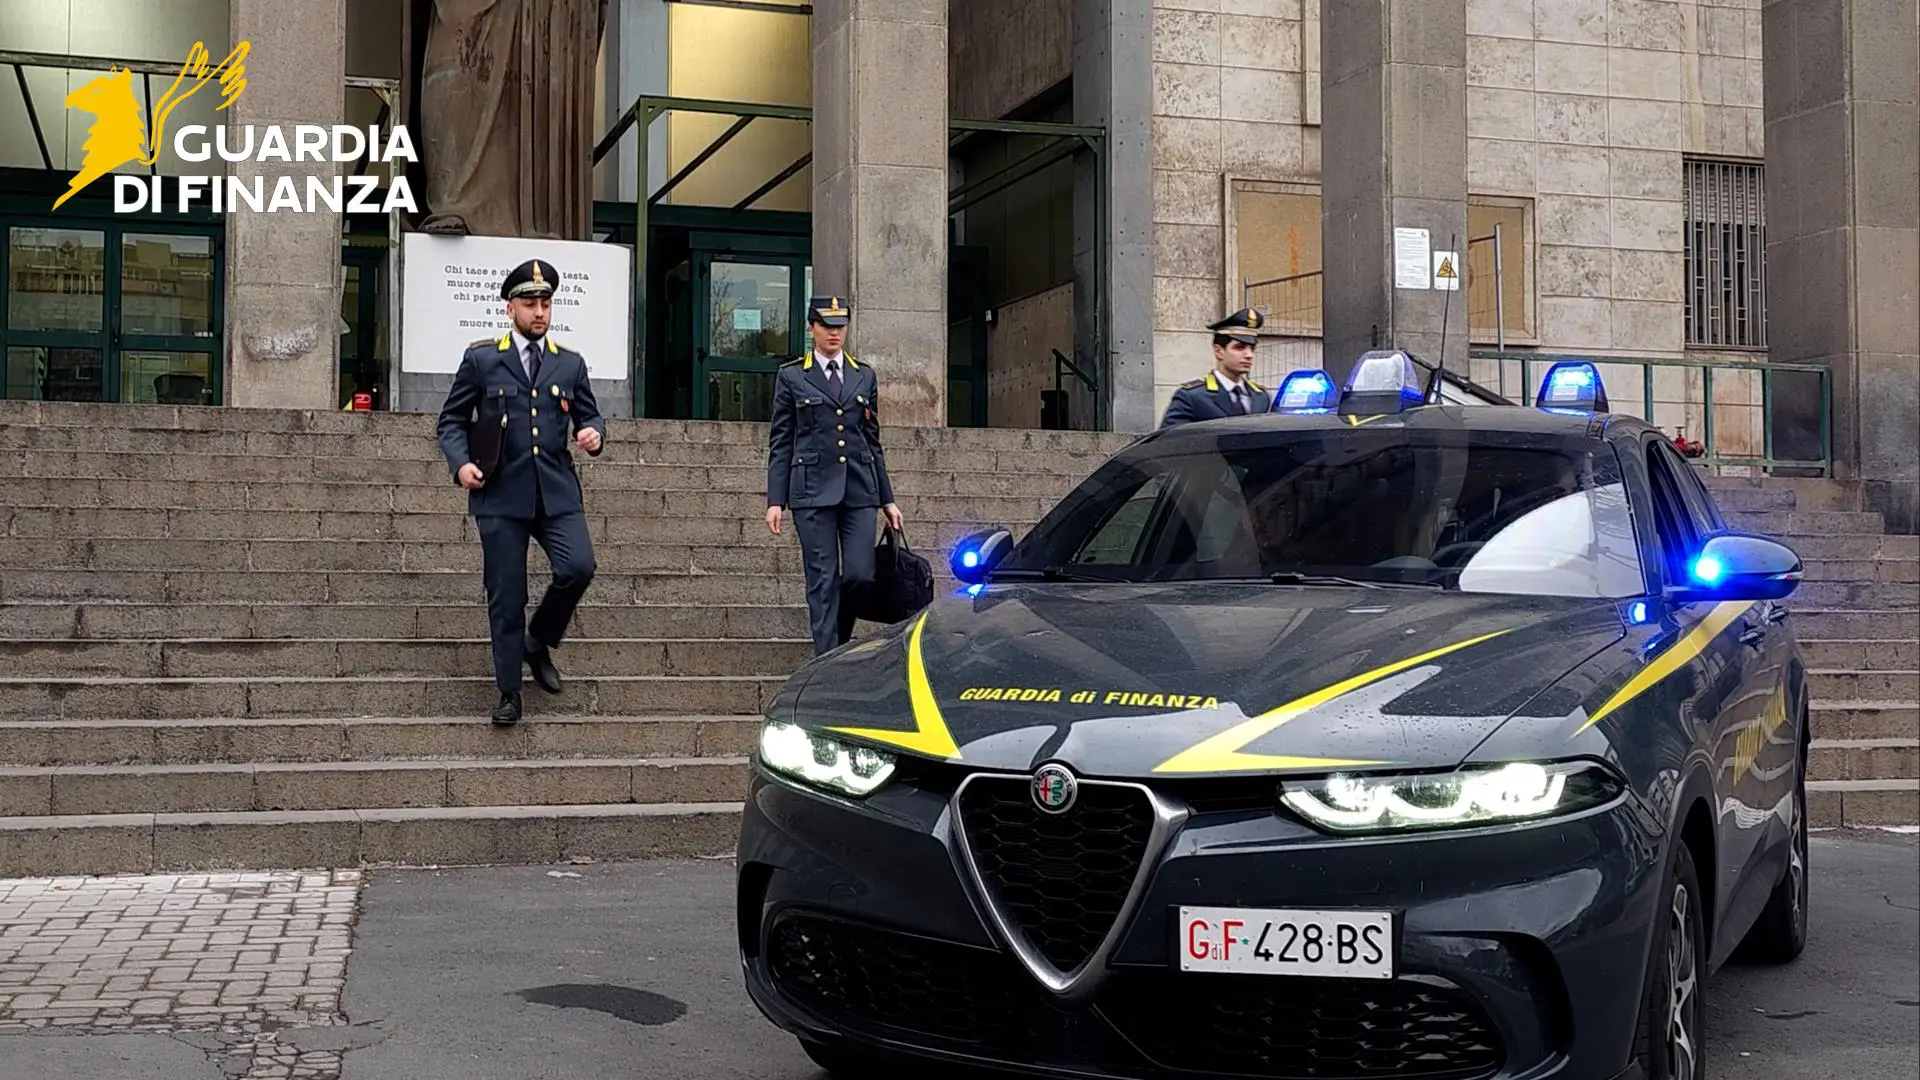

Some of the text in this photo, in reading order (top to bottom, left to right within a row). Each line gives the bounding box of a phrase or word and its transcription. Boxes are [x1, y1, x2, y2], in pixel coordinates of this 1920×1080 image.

[444, 265, 463, 274] Chi
[465, 267, 488, 275] tace
[562, 272, 590, 280] testa
[447, 279, 482, 288] muore
[560, 284, 571, 292] lo
[573, 285, 586, 295] fa,
[486, 307, 491, 315] a
[459, 319, 494, 328] muore
[959, 688, 1220, 710] GUARDIA di FINANZA
